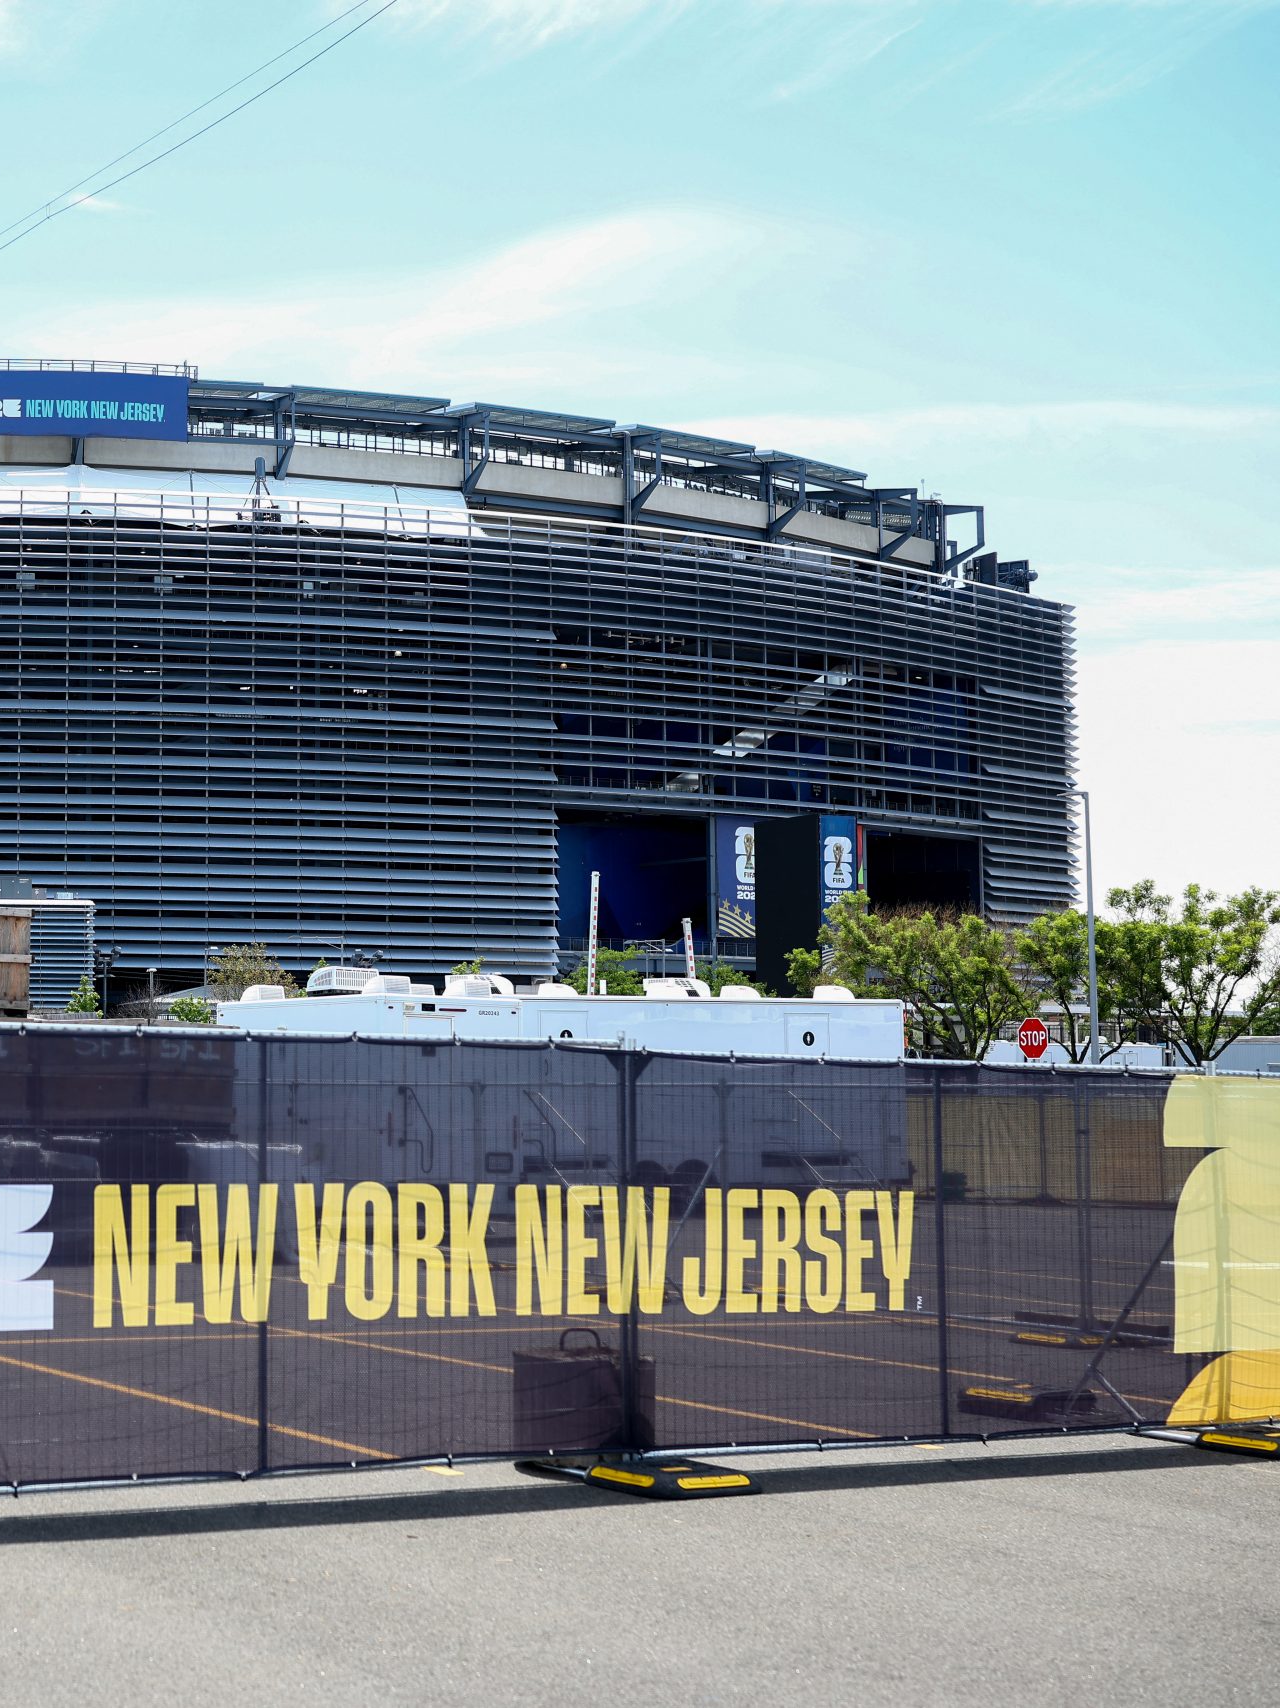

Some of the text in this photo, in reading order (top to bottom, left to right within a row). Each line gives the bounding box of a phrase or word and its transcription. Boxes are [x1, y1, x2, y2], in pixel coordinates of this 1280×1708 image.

[26, 400, 54, 418] NEW
[56, 400, 88, 419] YORK
[91, 401, 118, 420] NEW
[120, 402, 164, 422] JERSEY
[736, 890, 755, 900] 202
[1020, 1031, 1046, 1046] STOP
[93, 1182, 278, 1329] NEW
[294, 1182, 498, 1322] YORK
[515, 1184, 671, 1317] NEW
[682, 1187, 915, 1316] JERSEY
